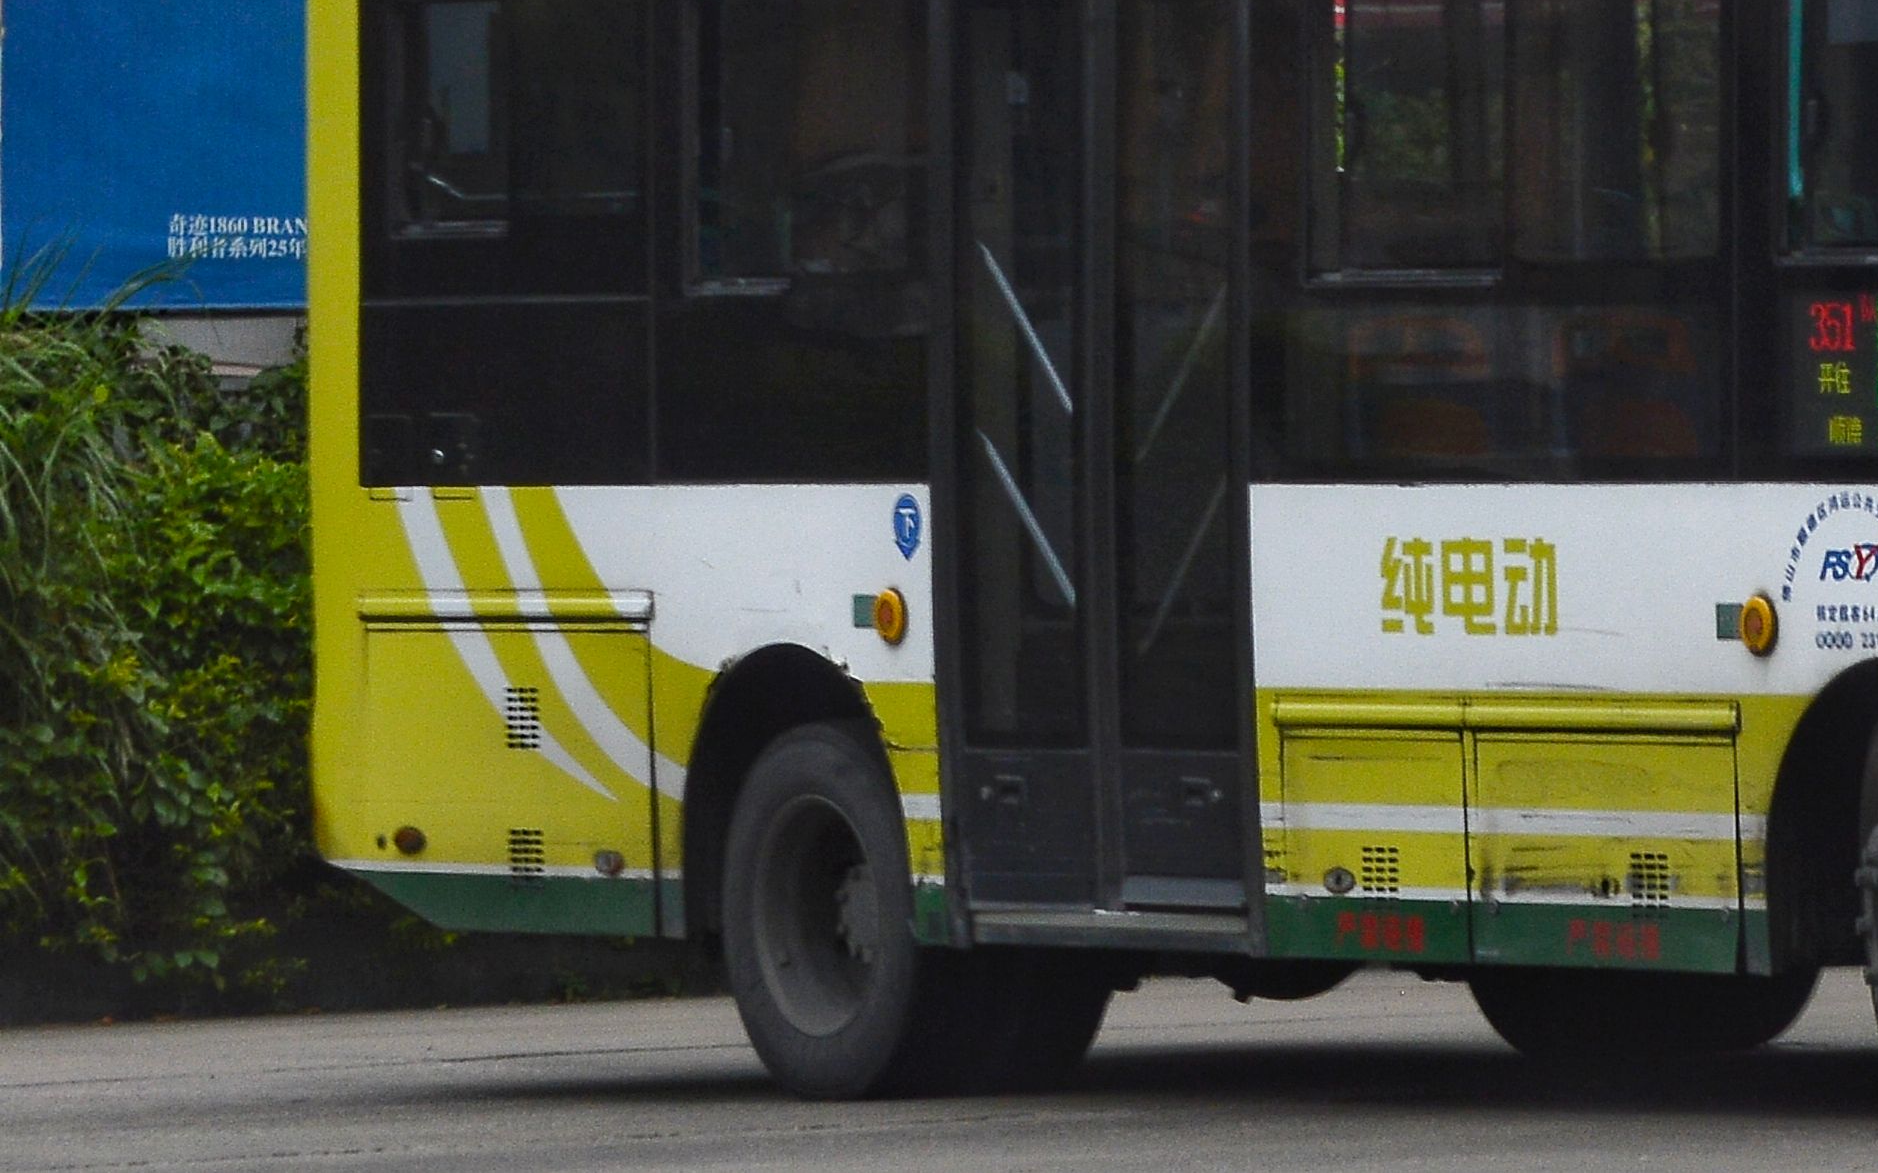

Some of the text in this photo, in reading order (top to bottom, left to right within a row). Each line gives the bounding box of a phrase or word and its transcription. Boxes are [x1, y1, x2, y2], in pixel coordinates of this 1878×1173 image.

[1808, 302, 1855, 351] 351
[1381, 536, 1558, 635] 纯电动
